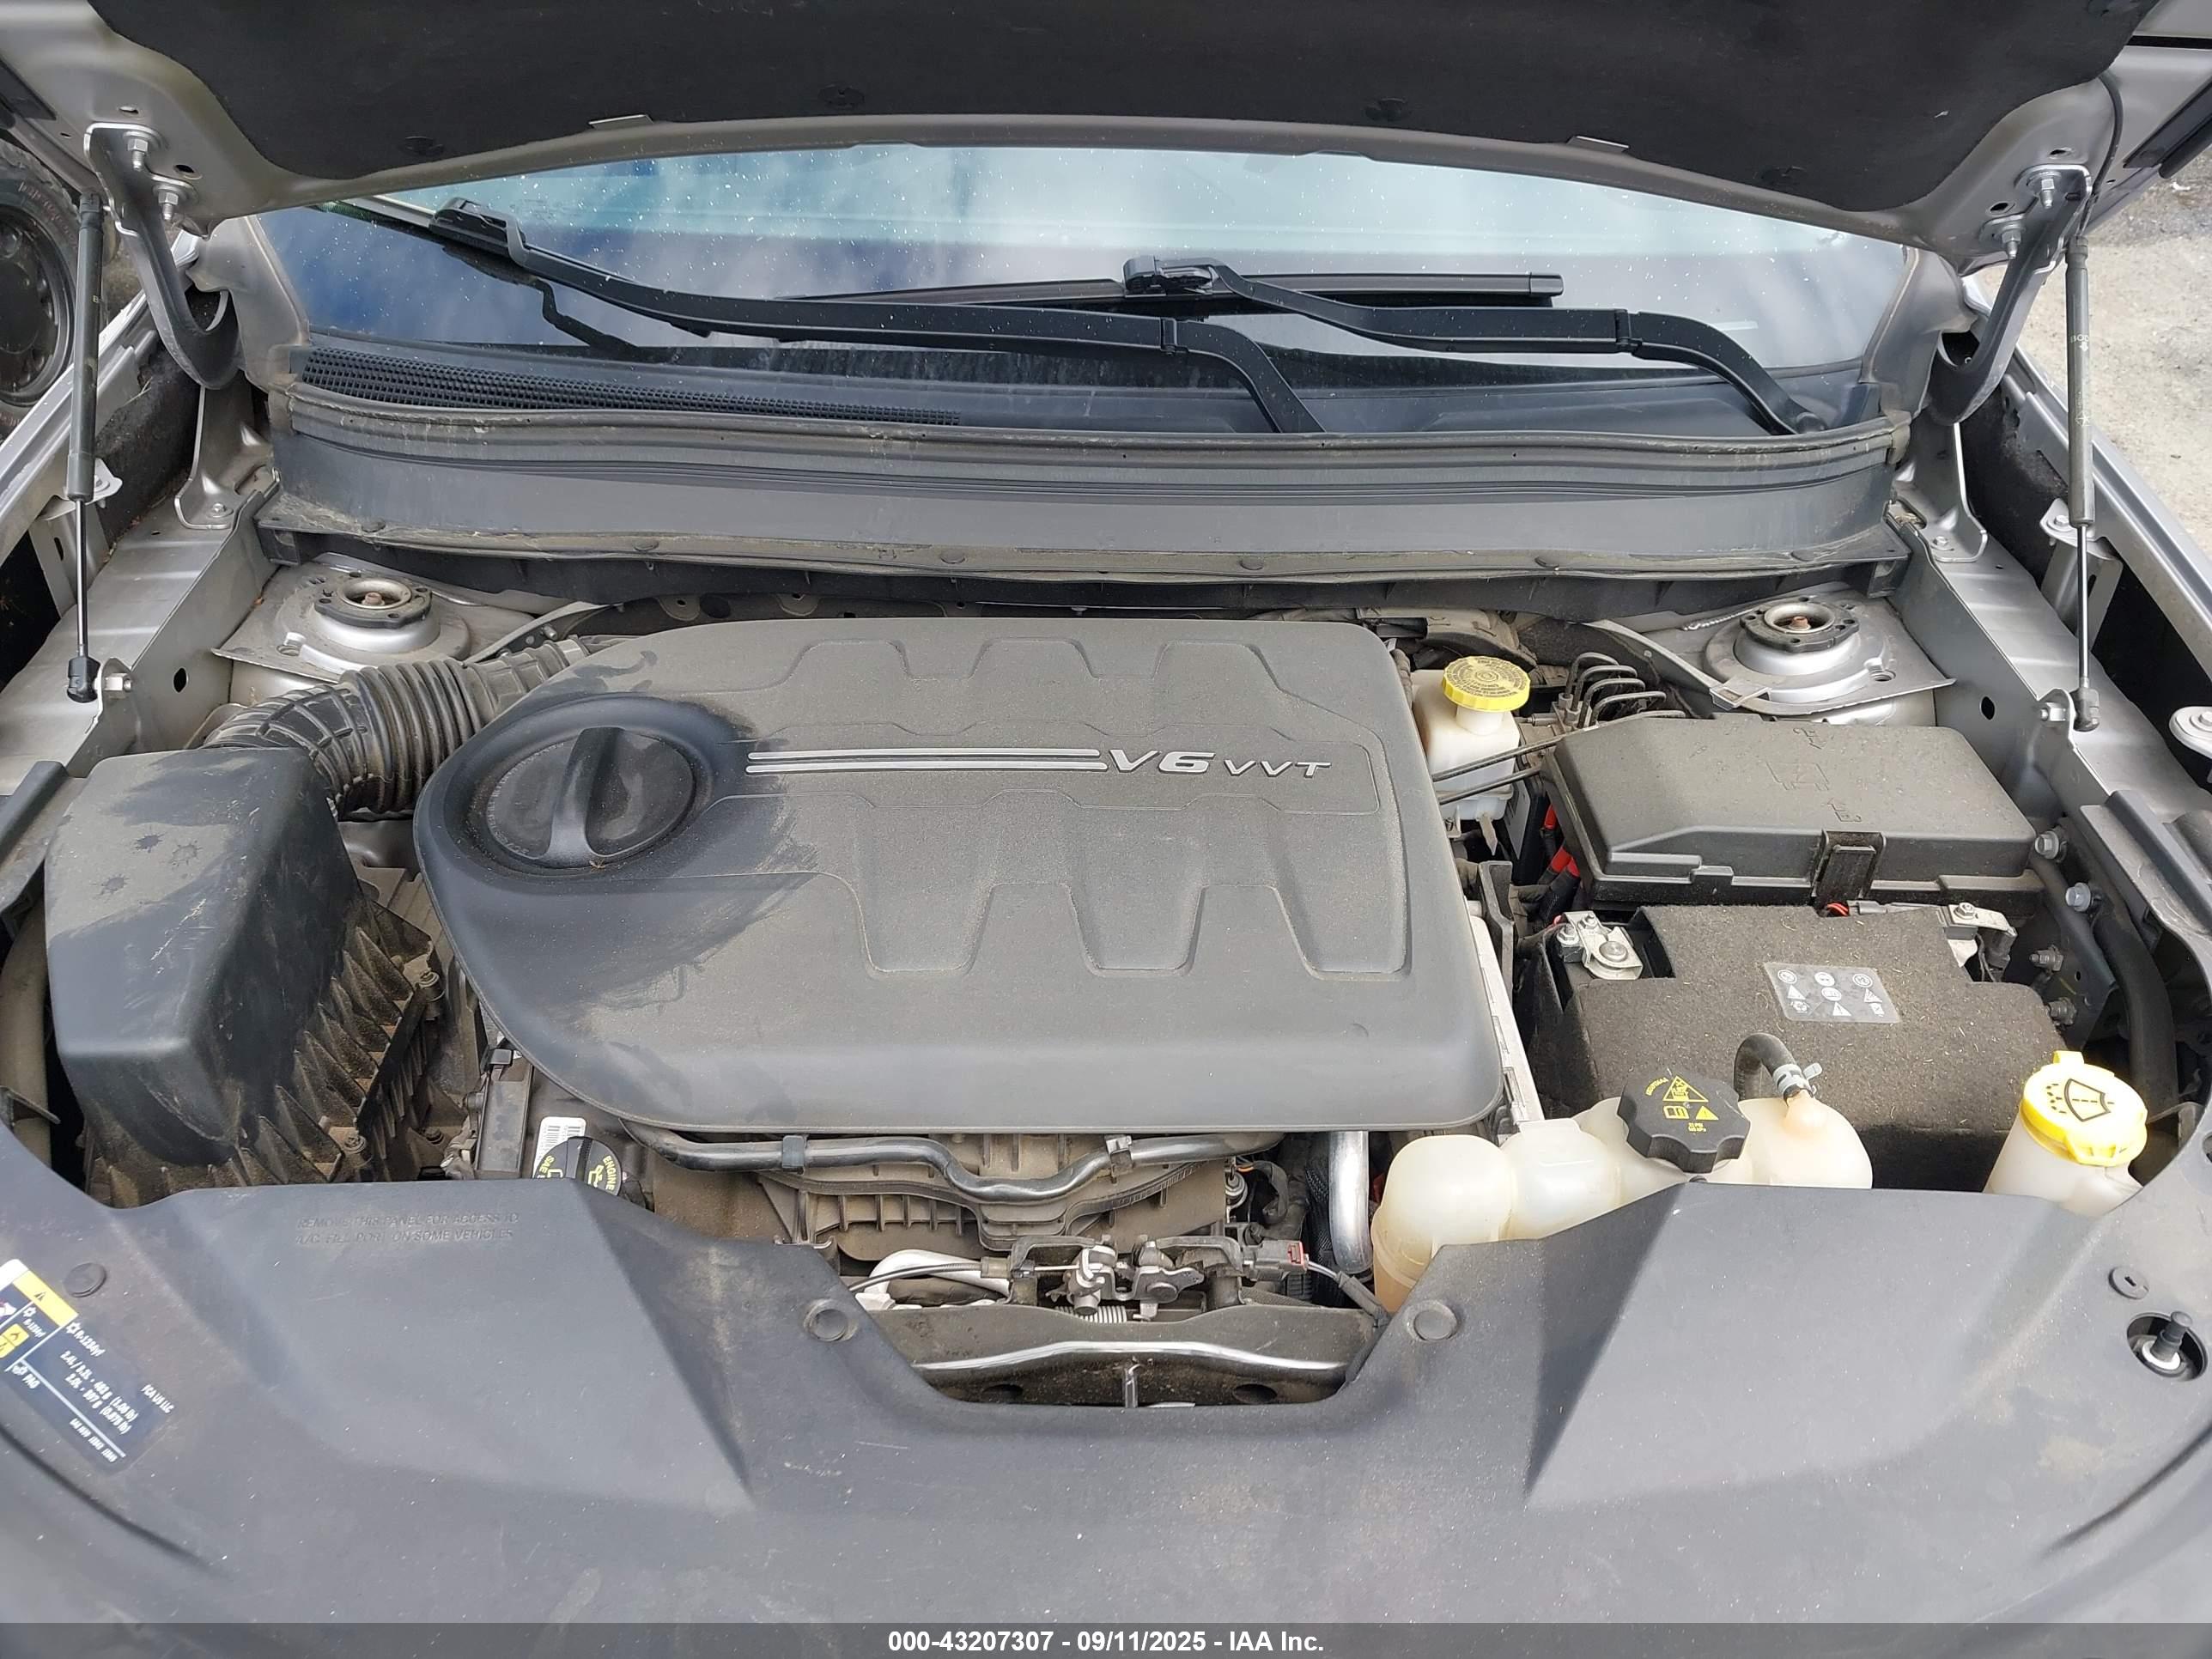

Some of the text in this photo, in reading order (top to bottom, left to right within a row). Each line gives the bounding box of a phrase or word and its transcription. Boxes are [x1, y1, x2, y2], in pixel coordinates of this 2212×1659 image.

[1109, 749, 1331, 777] V6 VVT
[538, 1155, 555, 1174] SAE
[602, 1155, 615, 1191] ENGINE
[384, 1214, 422, 1228] PANEL
